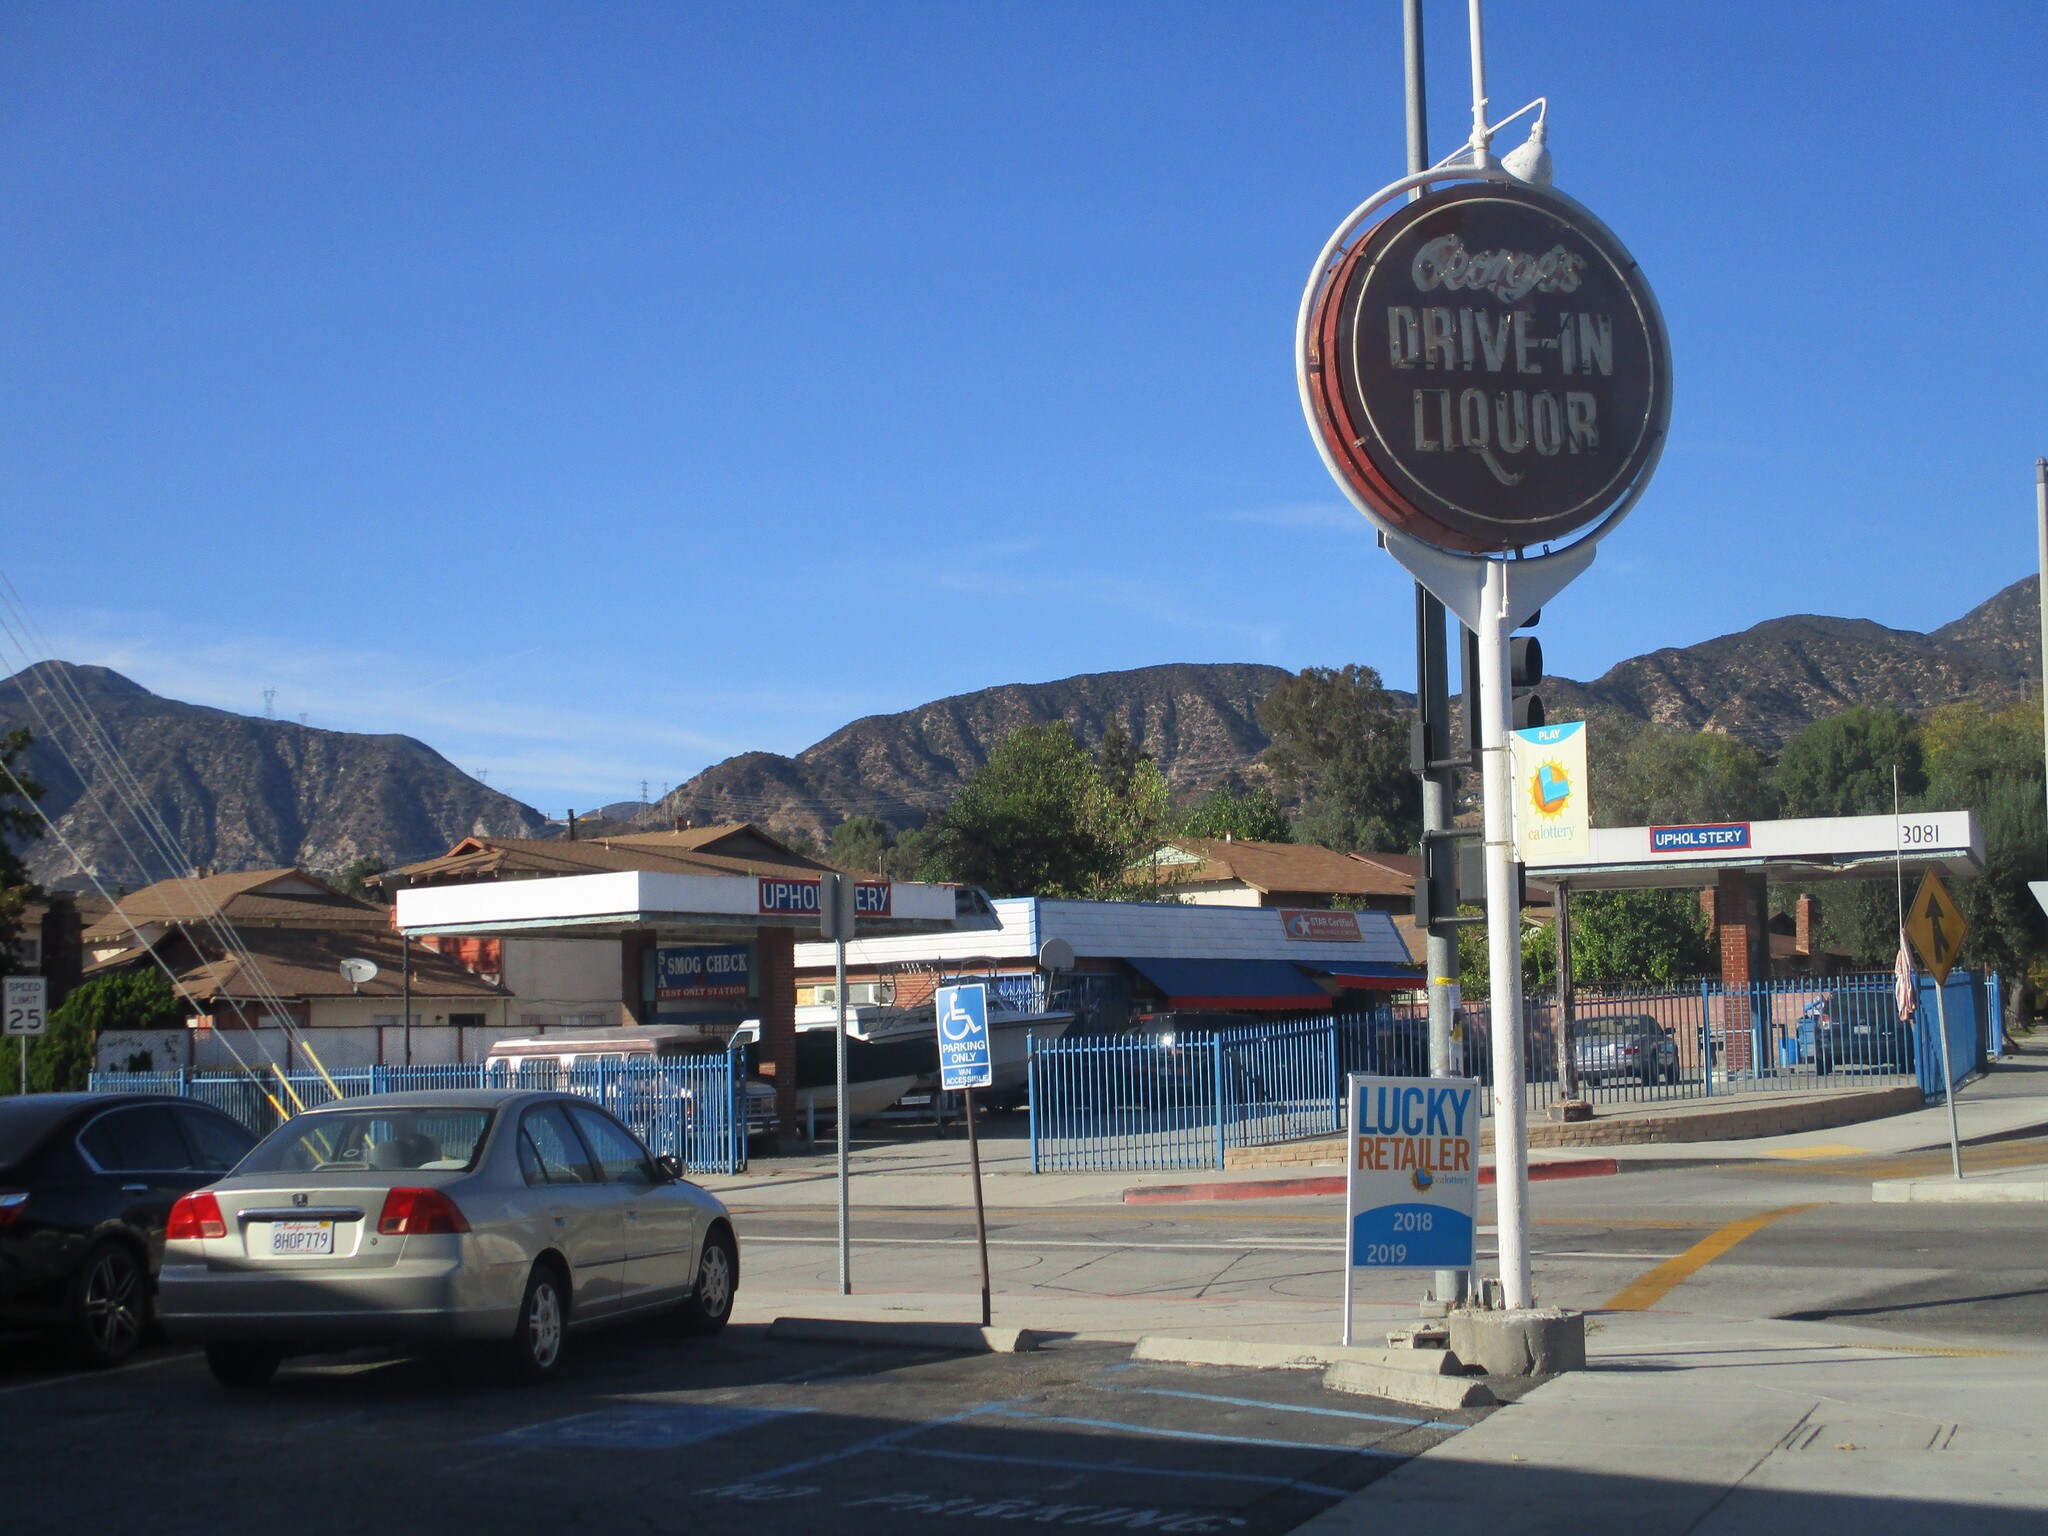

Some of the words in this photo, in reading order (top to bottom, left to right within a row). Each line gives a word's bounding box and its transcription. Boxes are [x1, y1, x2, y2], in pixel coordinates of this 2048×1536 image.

[1387, 305, 1614, 376] DRIVE-IN
[1413, 387, 1600, 487] LIQUOR
[1538, 729, 1560, 741] PLAY
[1528, 824, 1575, 841] calottery
[1655, 830, 1742, 846] UPHOLSTERY
[1902, 825, 1940, 844] 3081
[762, 883, 888, 911] UPHOLERY
[667, 957, 700, 975] SMOG
[706, 954, 747, 973] CHECK
[9, 982, 41, 992] SPEED
[661, 989, 680, 998] TEST
[684, 988, 705, 996] ONLY
[707, 986, 746, 996] STATION
[12, 996, 38, 1005] LIMIT
[9, 1008, 42, 1030] 25
[943, 1041, 985, 1053] PARKING
[951, 1052, 976, 1063] ONLY
[947, 1075, 987, 1085] ACCESSIBLE
[1359, 1086, 1472, 1136] LUCKY
[1358, 1137, 1470, 1171] RETAILER
[1393, 1212, 1433, 1231] 2018
[1367, 1244, 1407, 1263] 2019
